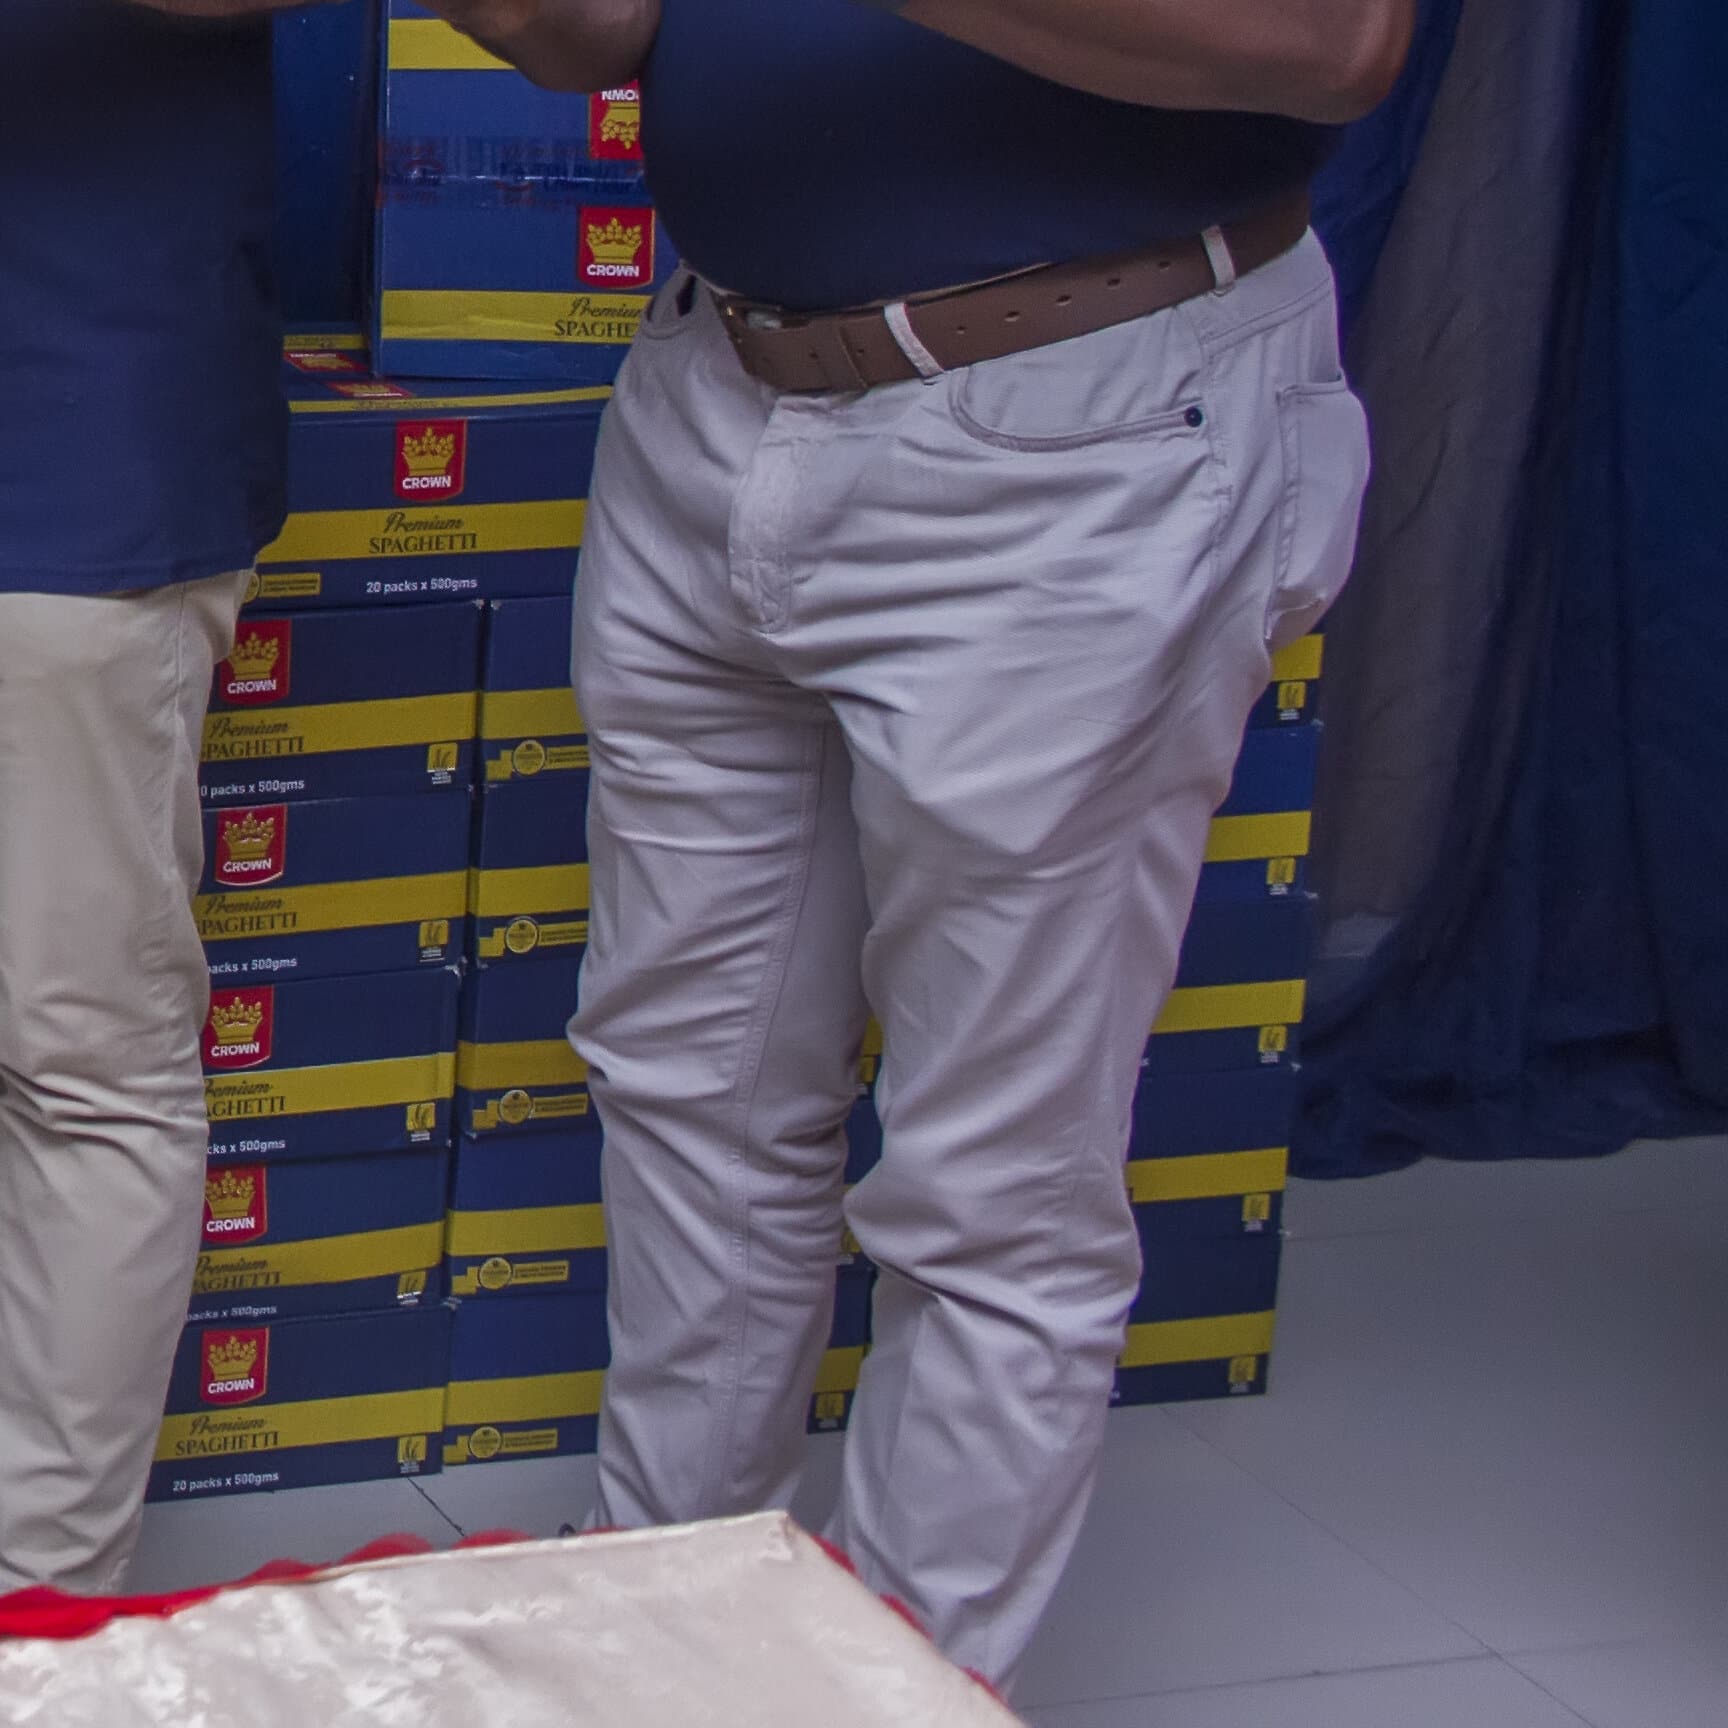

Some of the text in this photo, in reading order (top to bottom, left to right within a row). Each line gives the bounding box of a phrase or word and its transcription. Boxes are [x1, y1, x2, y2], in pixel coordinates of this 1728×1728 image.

[601, 89, 639, 101] OWN
[586, 263, 640, 277] CROWN
[554, 320, 636, 338] SPAGHE
[402, 475, 452, 490] CROWN
[382, 511, 465, 534] Premium
[368, 532, 478, 554] SPAGHETTI
[365, 577, 478, 595] 20 packs x 500gms
[227, 679, 277, 694] CROWN
[208, 716, 289, 738] Premium
[210, 779, 306, 798] packs x 500gms
[223, 858, 272, 873] CROWN
[206, 895, 283, 915] Premium
[241, 962, 248, 972] x
[251, 957, 298, 972] 500gms
[211, 1042, 260, 1057] CROWN
[229, 1144, 237, 1153] x
[239, 1139, 286, 1153] 500gms
[206, 1216, 255, 1232] CROWN
[207, 1378, 255, 1394] CROWN
[189, 1415, 267, 1436] Premium
[175, 1430, 279, 1456] SPAGHETTI
[172, 1472, 280, 1492] 20 packs x 500gms
